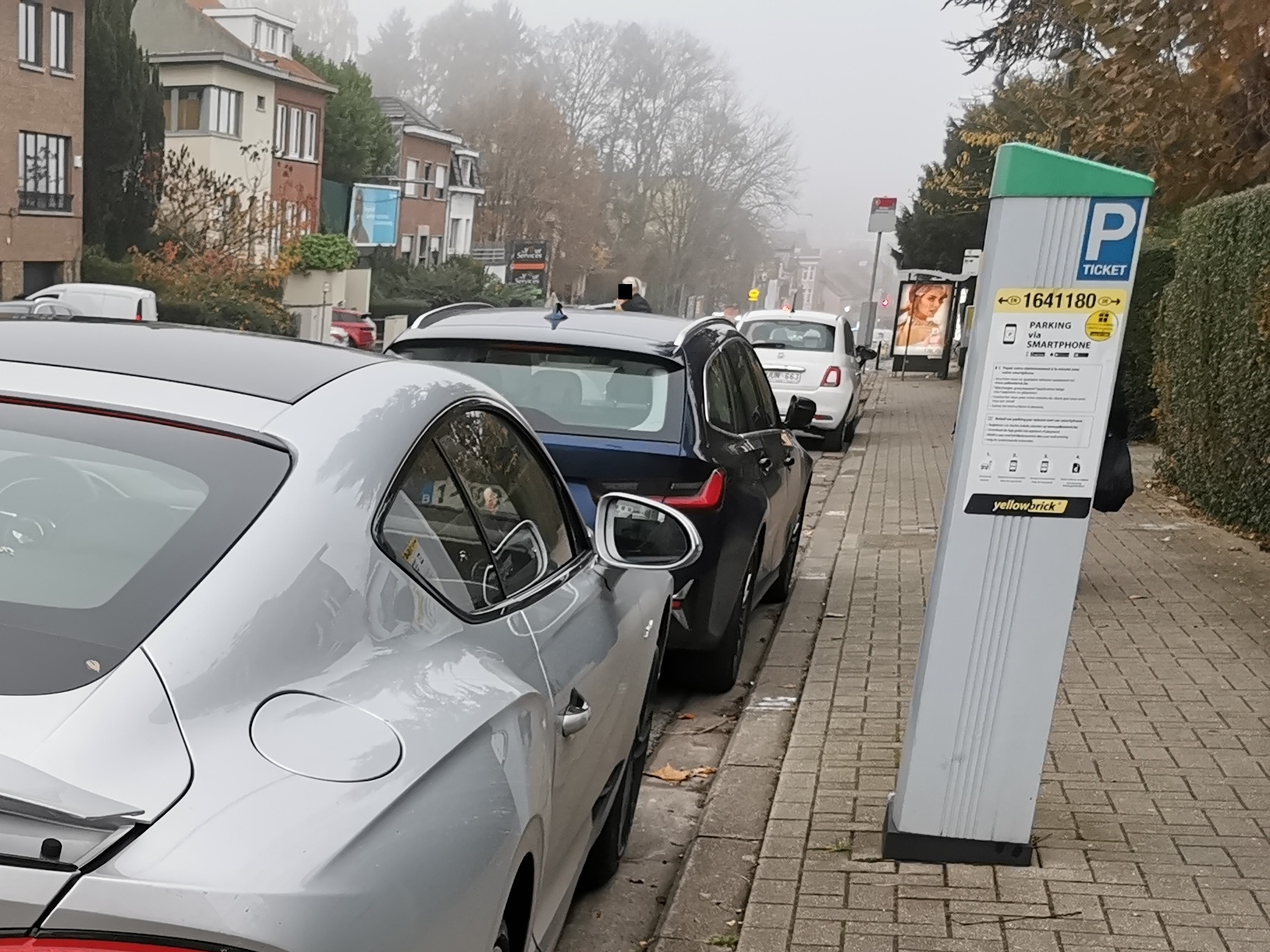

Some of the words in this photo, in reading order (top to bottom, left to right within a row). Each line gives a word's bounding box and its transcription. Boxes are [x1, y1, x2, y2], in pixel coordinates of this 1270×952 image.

[1085, 203, 1136, 261] P
[1083, 264, 1128, 276] TICKET
[1023, 292, 1097, 309] 1641180
[1029, 321, 1072, 330] PARKING
[1028, 331, 1042, 339] via
[1026, 340, 1091, 350] SMARTPHONE
[992, 499, 1056, 512] yellowbrick
